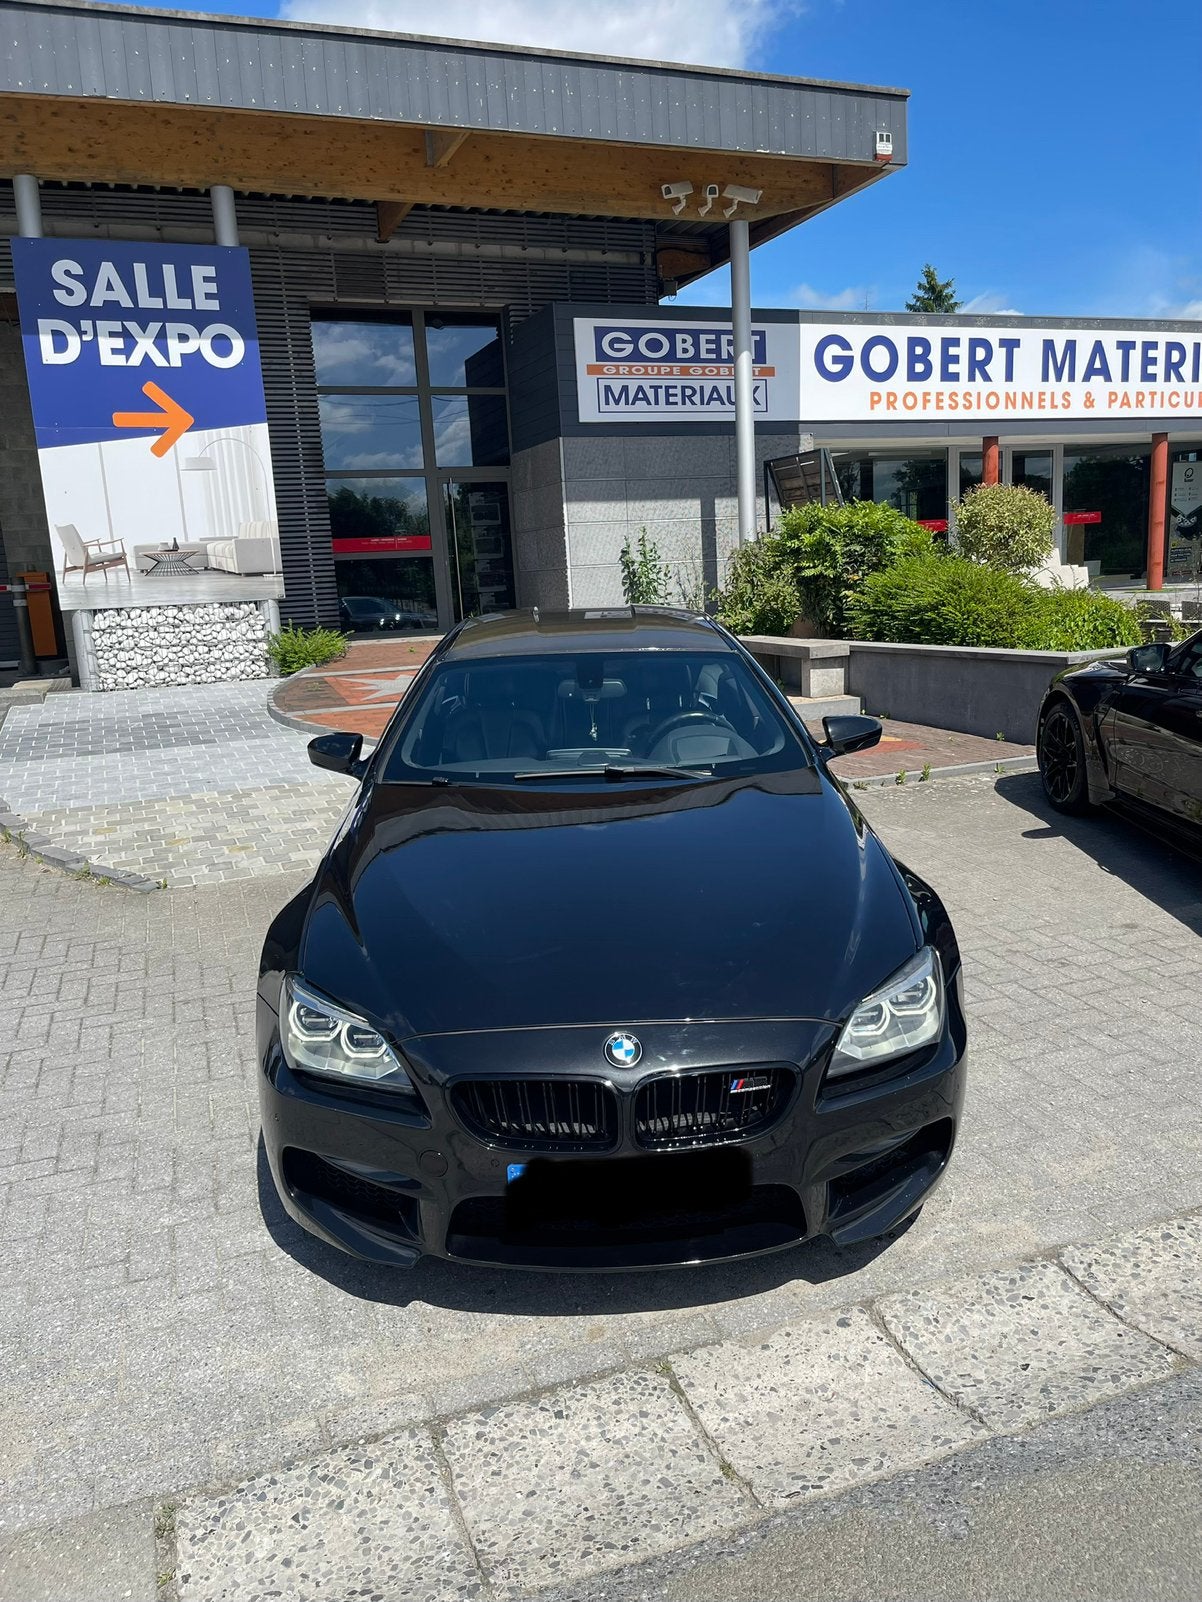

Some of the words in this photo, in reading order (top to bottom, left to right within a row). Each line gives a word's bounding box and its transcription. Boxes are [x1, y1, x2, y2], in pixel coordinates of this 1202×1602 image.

[52, 259, 220, 310] SALLE
[603, 366, 680, 376] GROUPE
[689, 367, 761, 376] GOBT
[814, 334, 1021, 383] GOBERT
[1041, 339, 1201, 383] MATERI
[869, 392, 1072, 410] PROFESSIONNELS
[1083, 391, 1096, 409] &
